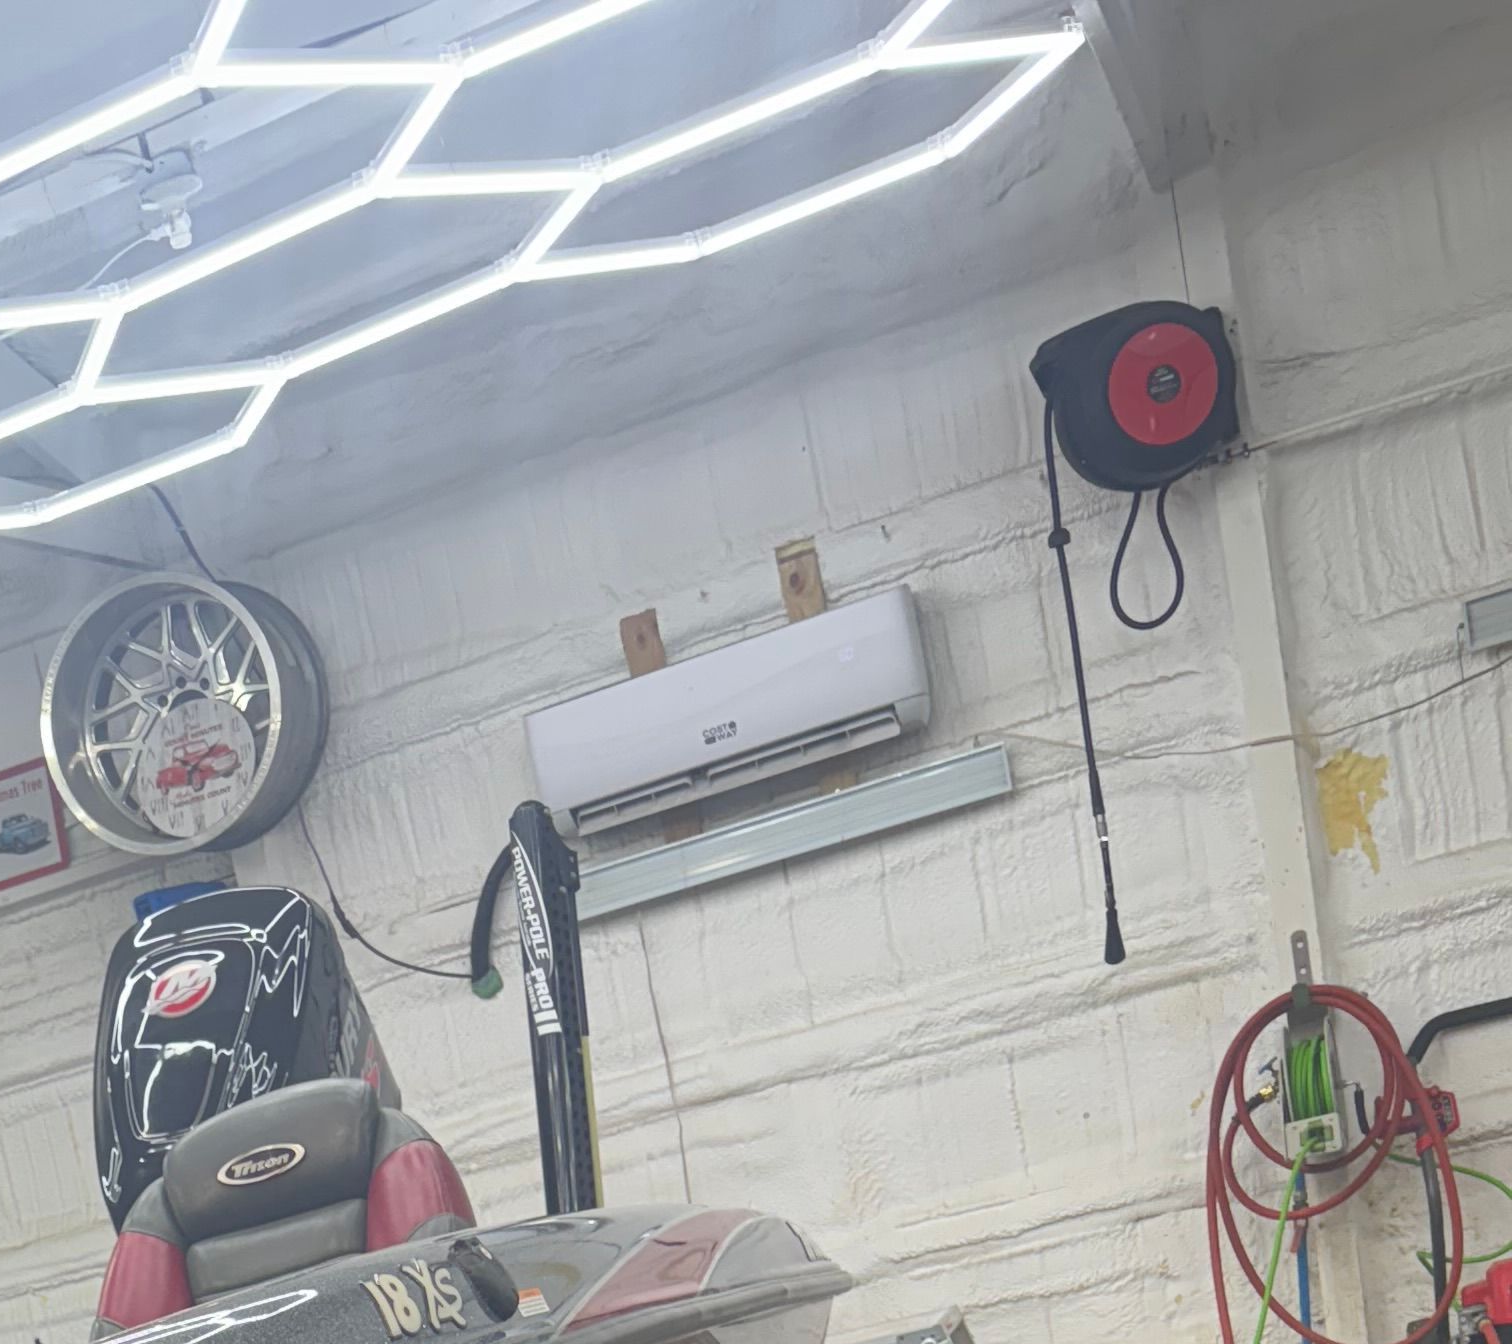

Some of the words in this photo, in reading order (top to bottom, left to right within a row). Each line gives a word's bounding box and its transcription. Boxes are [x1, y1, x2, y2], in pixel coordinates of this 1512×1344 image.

[20, 778, 43, 795] Tree
[511, 846, 550, 960] POWER-POLE
[530, 967, 554, 1009] PRO
[231, 1153, 289, 1178] Triton
